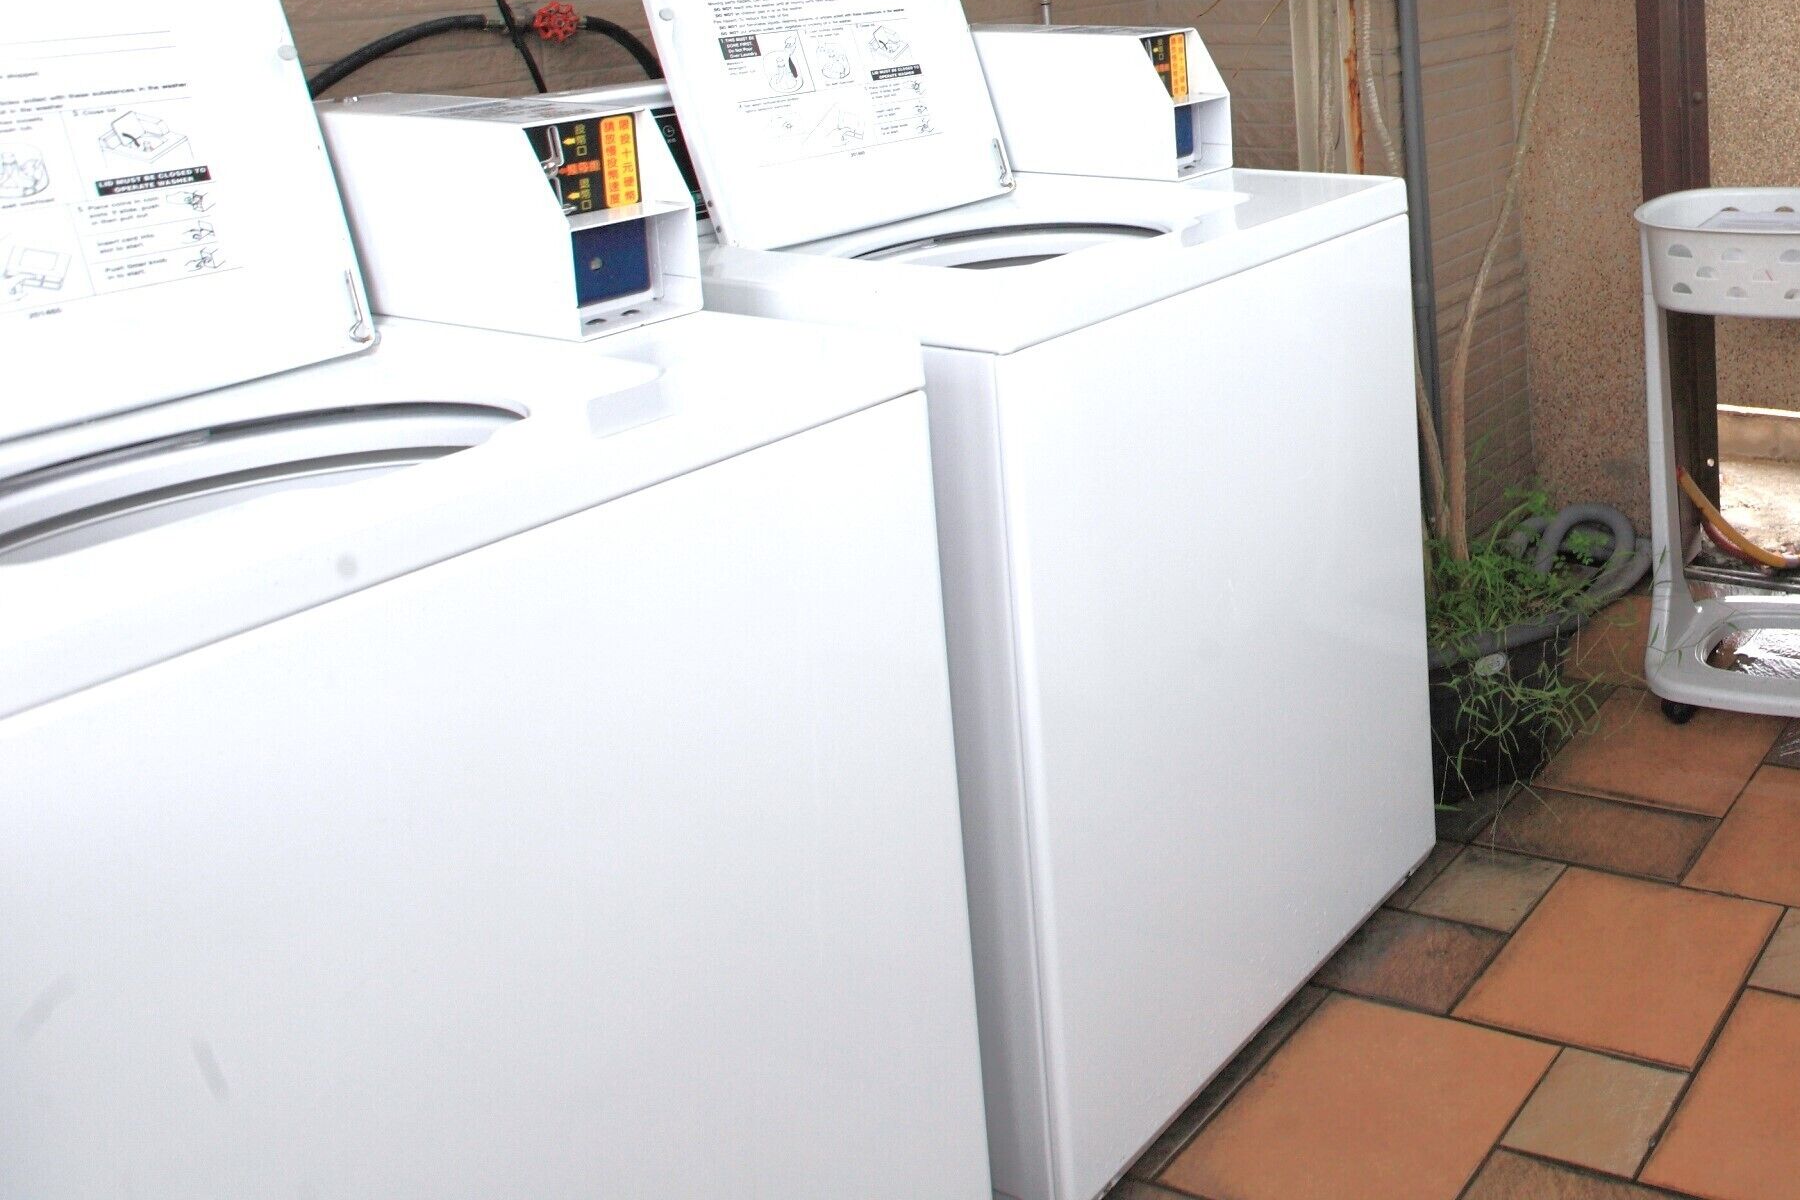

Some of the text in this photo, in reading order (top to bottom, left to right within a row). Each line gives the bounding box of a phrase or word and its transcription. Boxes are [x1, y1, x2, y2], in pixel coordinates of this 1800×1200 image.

[98, 180, 113, 188] LID
[115, 177, 141, 185] MUST
[143, 174, 156, 182] BE
[158, 169, 193, 180] CLOSED
[113, 182, 156, 194] OPERATE
